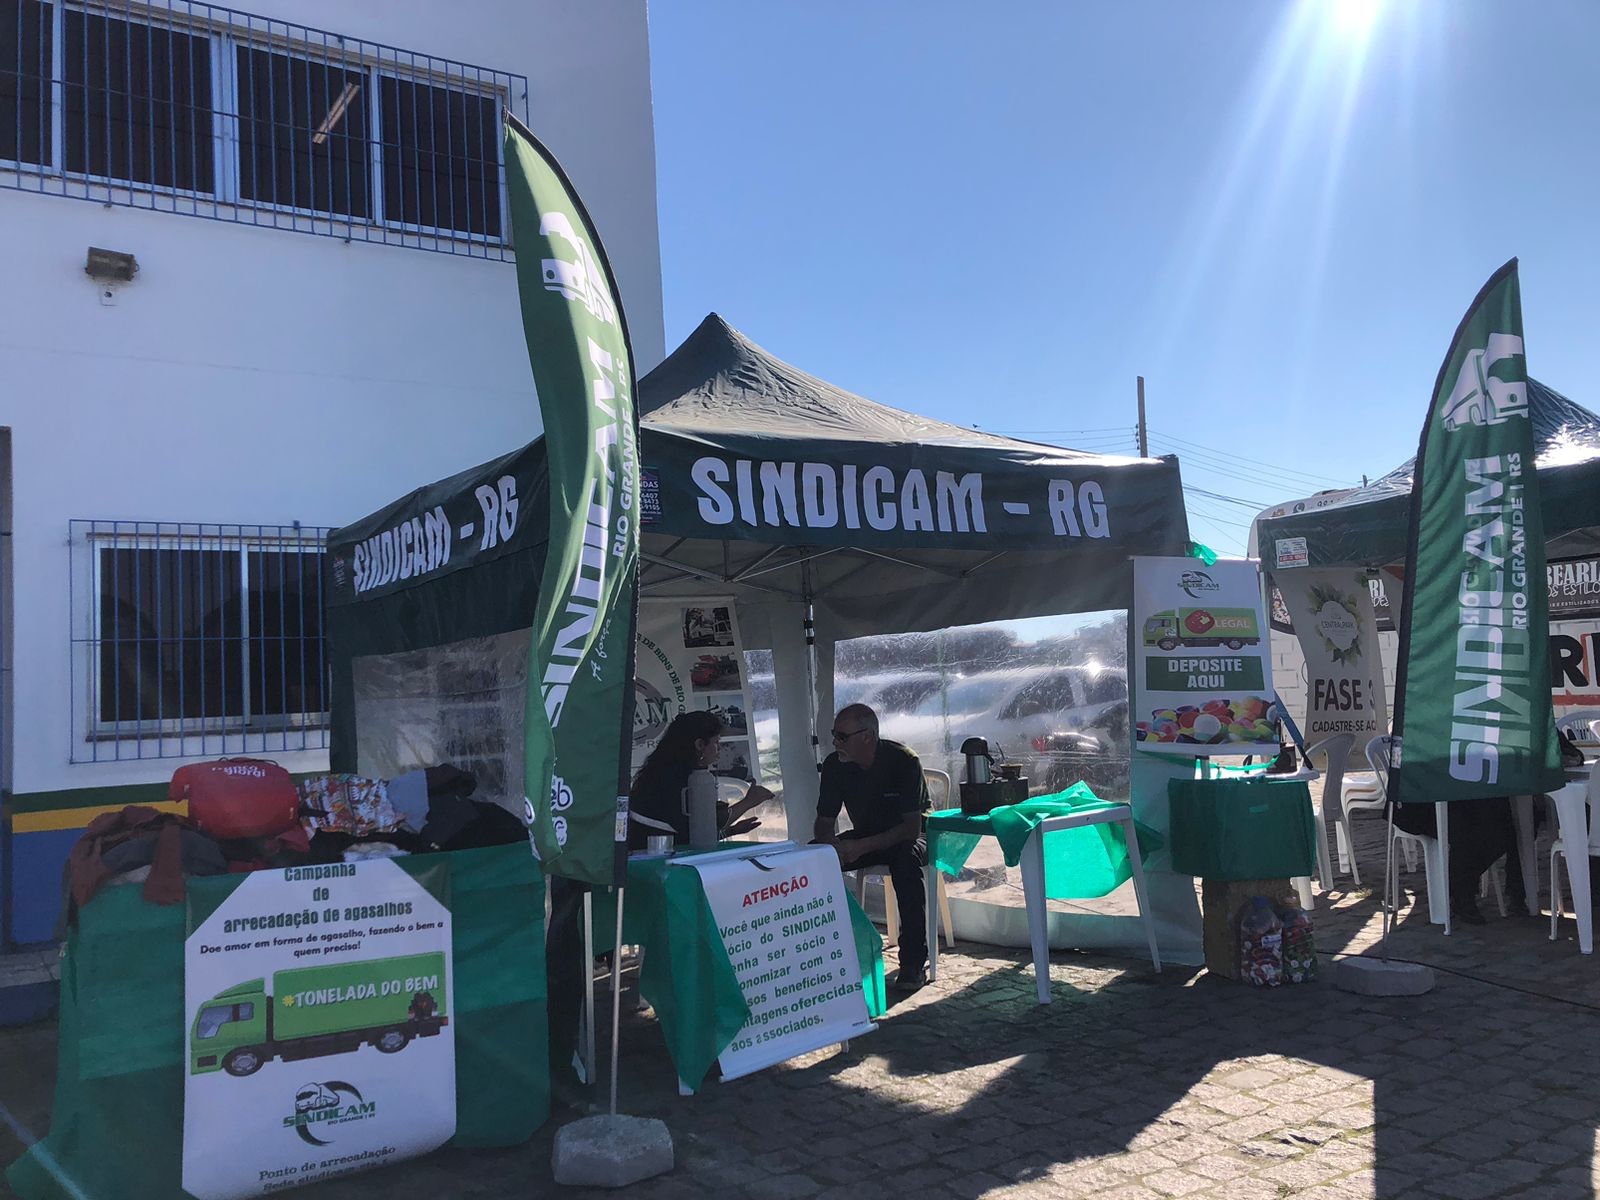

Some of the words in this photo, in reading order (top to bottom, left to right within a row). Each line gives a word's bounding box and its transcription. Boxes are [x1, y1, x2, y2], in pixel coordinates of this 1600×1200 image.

[1507, 452, 1522, 477] RS
[691, 457, 988, 534] SINDICAM
[1048, 478, 1112, 539] RG
[353, 506, 452, 596] SINDICAM
[474, 475, 519, 551] RG
[612, 519, 630, 559] RIO
[1509, 497, 1527, 588] GRANDE
[1214, 618, 1250, 629] LEGAL
[1449, 455, 1505, 785] SINDICAM
[1511, 592, 1528, 630] RIO
[642, 637, 656, 650] DE
[654, 647, 673, 671] BENS
[669, 671, 680, 684] DE
[675, 685, 686, 703] RIO
[1168, 658, 1243, 673] DEPOSITE
[1187, 675, 1225, 688] AQUI
[1314, 678, 1363, 711] FASE
[1312, 720, 1364, 733] CADASTRE-SE
[284, 862, 357, 882] Campanha
[312, 886, 330, 902] de
[742, 875, 809, 907] ATENÇÃO
[223, 908, 319, 933] arrecadação
[323, 907, 340, 924] de
[344, 901, 413, 923] agasalhos
[719, 920, 748, 939] Você
[751, 915, 771, 931] que
[773, 903, 804, 921] ainda
[806, 896, 825, 911] não
[826, 891, 833, 904] é
[727, 940, 752, 956] ócio
[760, 930, 774, 945] do
[782, 910, 837, 938] SINDICAM
[200, 944, 222, 954] Doe
[224, 941, 252, 952] amor
[254, 939, 270, 948] em
[273, 935, 303, 947] forma
[306, 932, 318, 943] de
[320, 928, 366, 942] agasalho,
[368, 924, 406, 937] fazendo
[416, 922, 437, 931] bem
[293, 947, 321, 958] quem
[324, 940, 361, 955] precisa!
[732, 956, 759, 974] enha
[767, 946, 786, 962] ser
[795, 935, 826, 953] sócio
[832, 931, 840, 941] e
[739, 964, 792, 991] onomizar
[800, 956, 823, 971] com
[830, 948, 843, 961] os
[747, 993, 767, 1008] sos
[775, 971, 833, 999] benefícios
[839, 966, 847, 977] e
[293, 982, 377, 1008] TONELADA
[381, 979, 401, 996] DO
[405, 974, 439, 994] BEM
[742, 1005, 789, 1030] ntagens
[790, 980, 863, 1012] oferecidas
[731, 1038, 753, 1053] aos
[755, 1013, 825, 1045] associados.
[259, 1166, 297, 1181] Ponto
[301, 1162, 317, 1173] de
[319, 1146, 396, 1169] arrecadação
